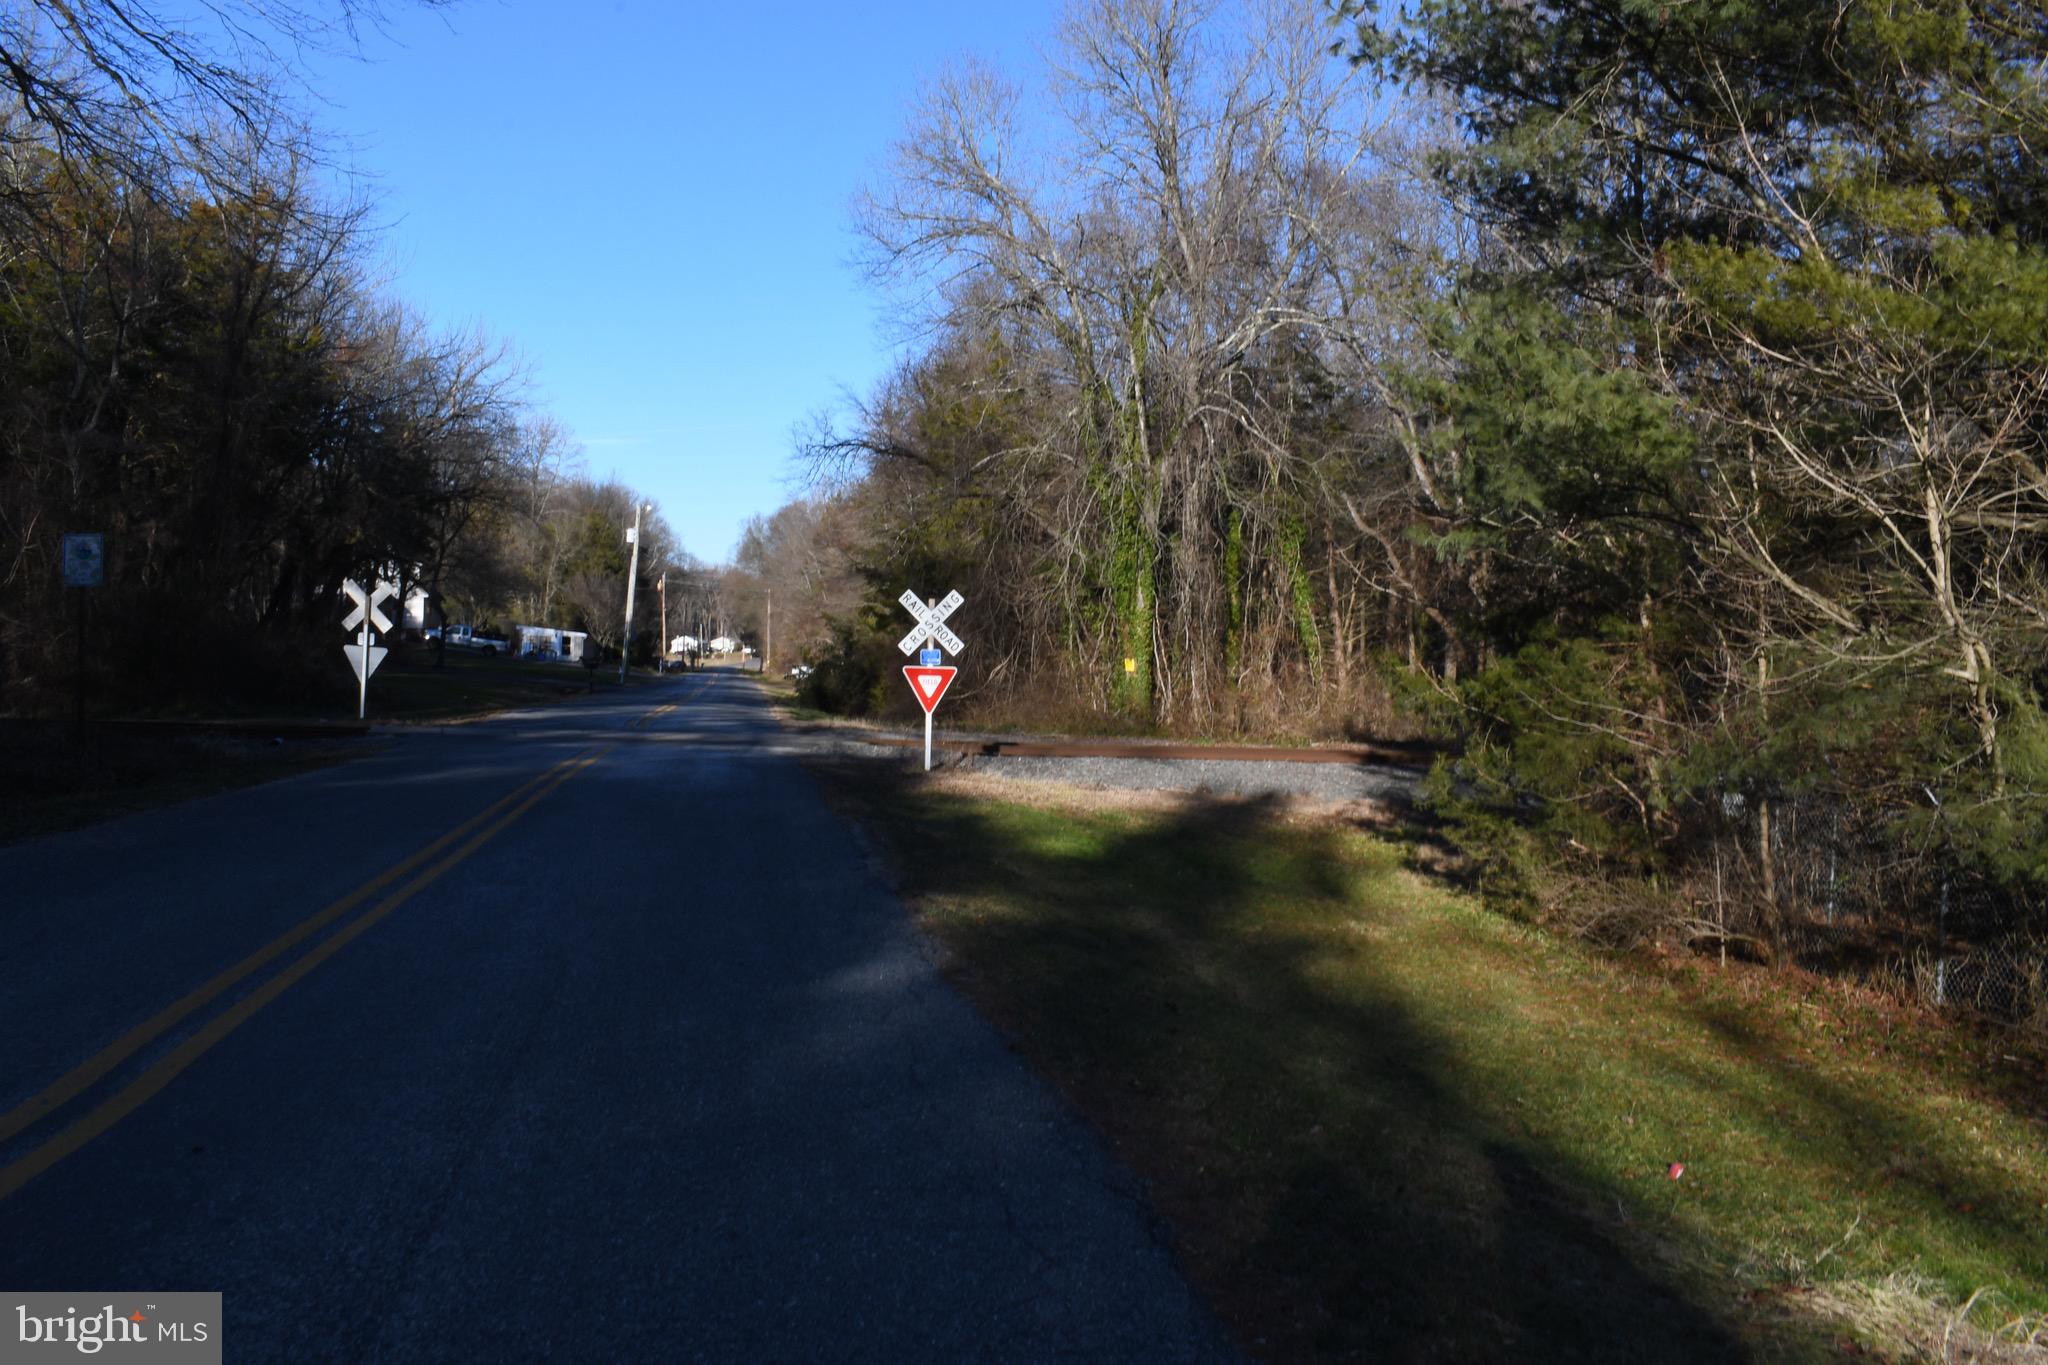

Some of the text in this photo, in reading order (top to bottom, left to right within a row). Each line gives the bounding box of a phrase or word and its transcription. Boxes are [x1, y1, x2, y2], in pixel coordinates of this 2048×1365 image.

[902, 593, 959, 651] RAIL ROAD
[903, 594, 960, 651] CROSSING
